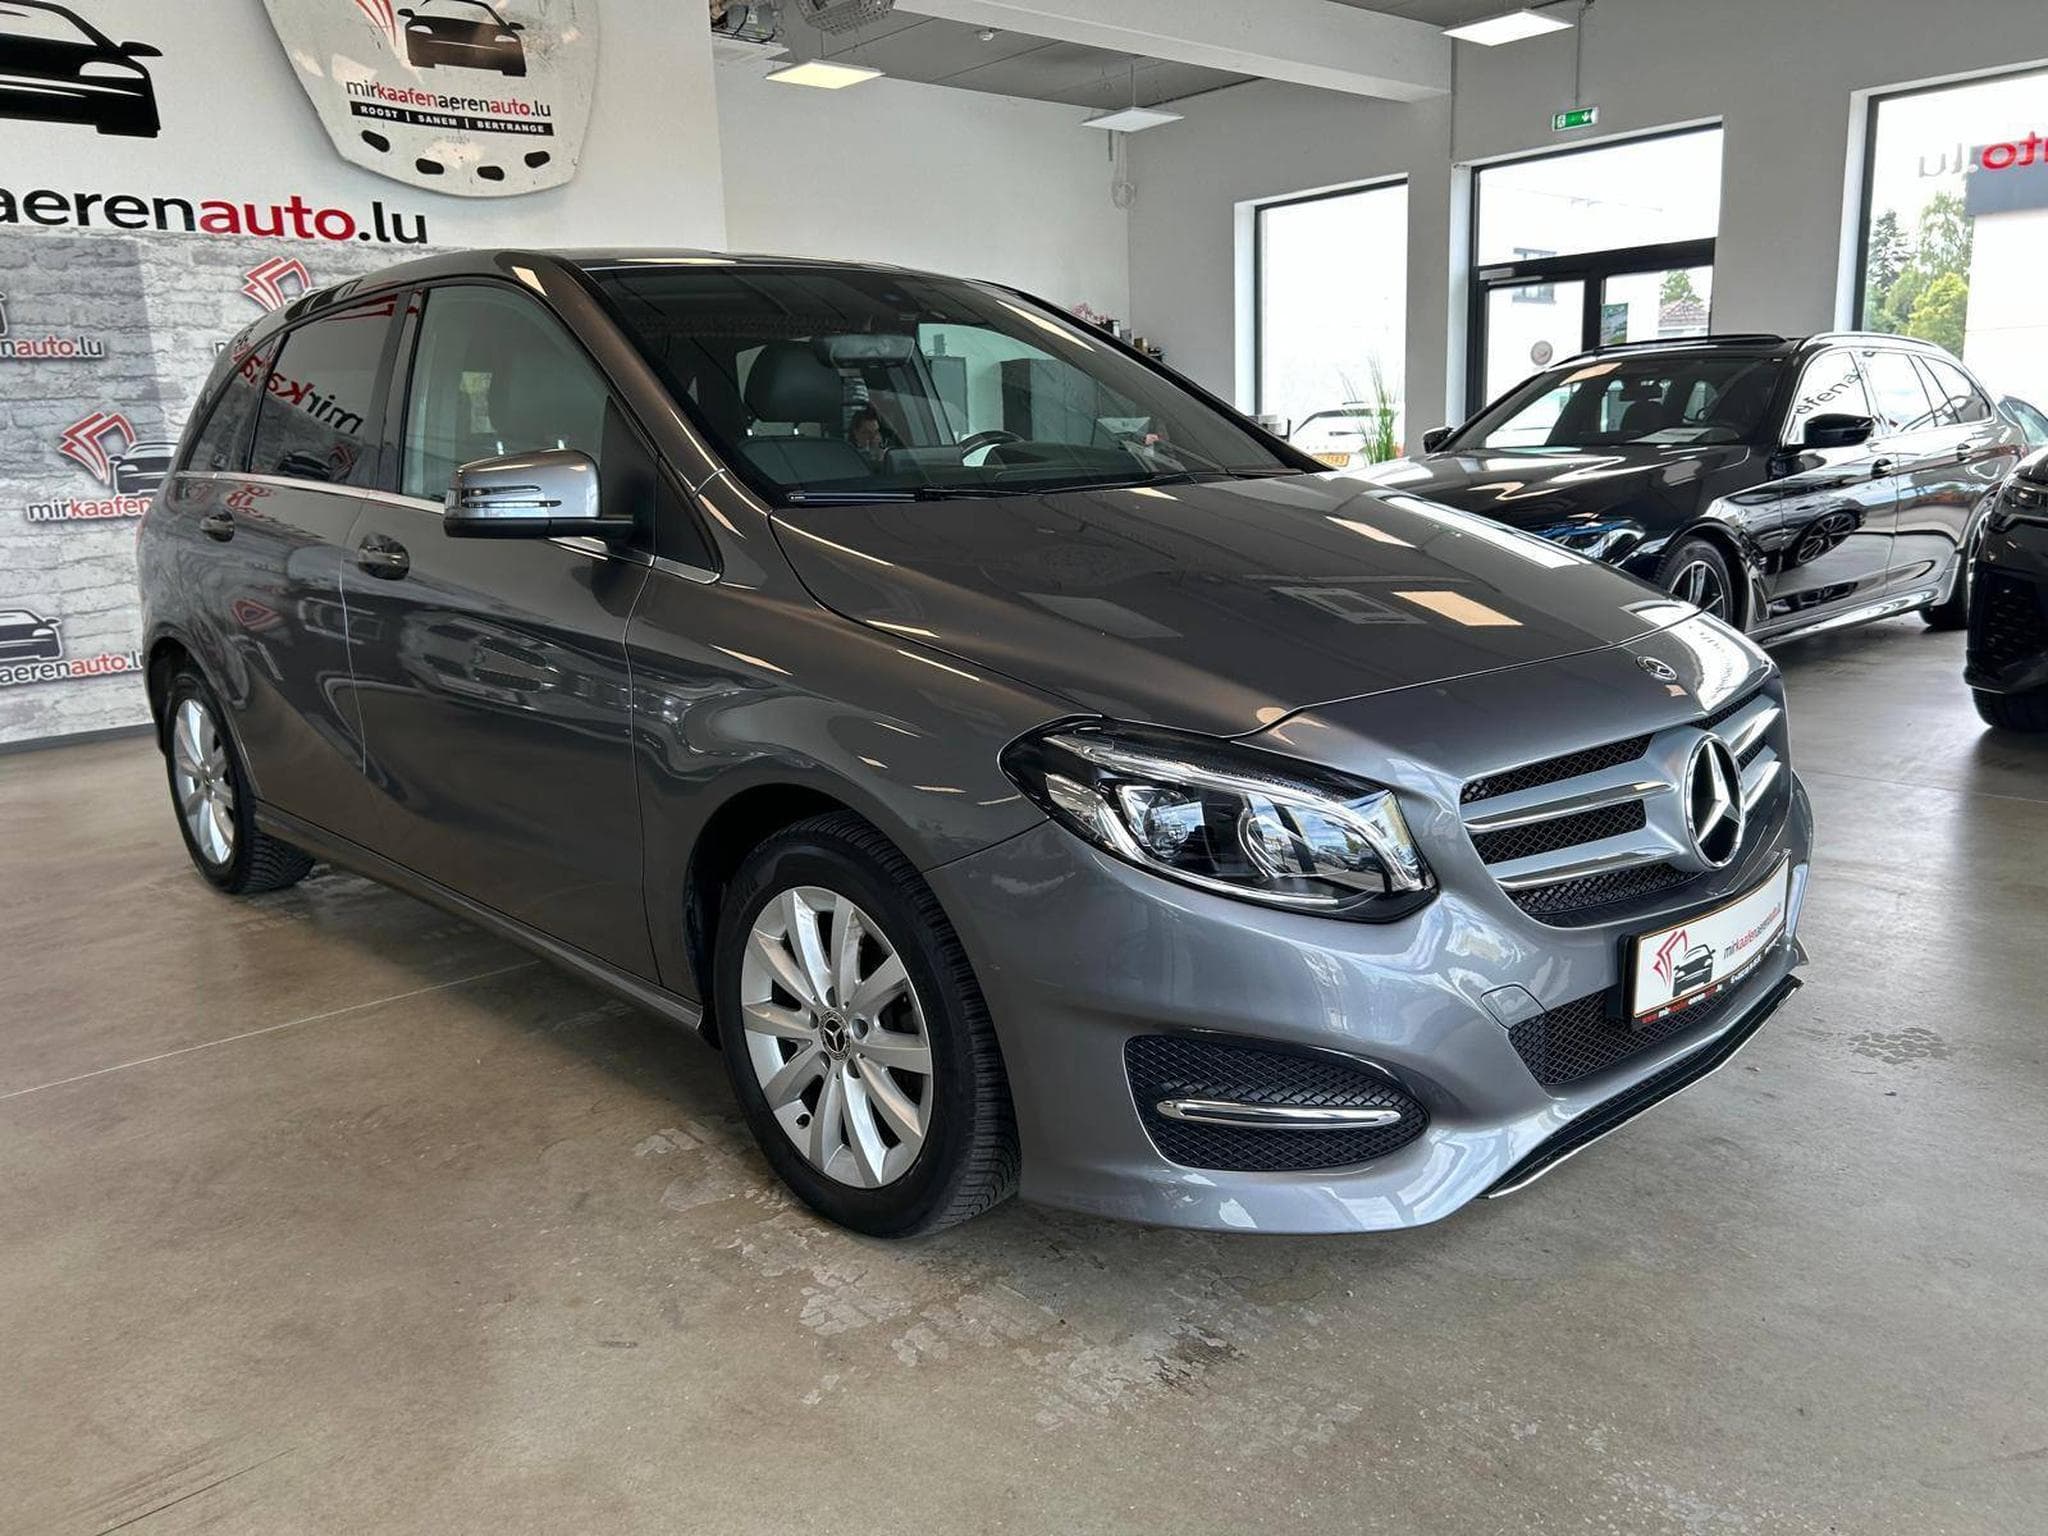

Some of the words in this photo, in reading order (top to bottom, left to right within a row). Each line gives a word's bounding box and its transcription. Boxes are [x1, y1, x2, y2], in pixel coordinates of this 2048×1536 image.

[346, 80, 552, 117] mirkaafenaerenauto.lu
[359, 105, 398, 119] ROOST
[418, 114, 458, 127] SANEM
[477, 121, 545, 134] BERTRANGE
[0, 651, 143, 684] aerenauto.l
